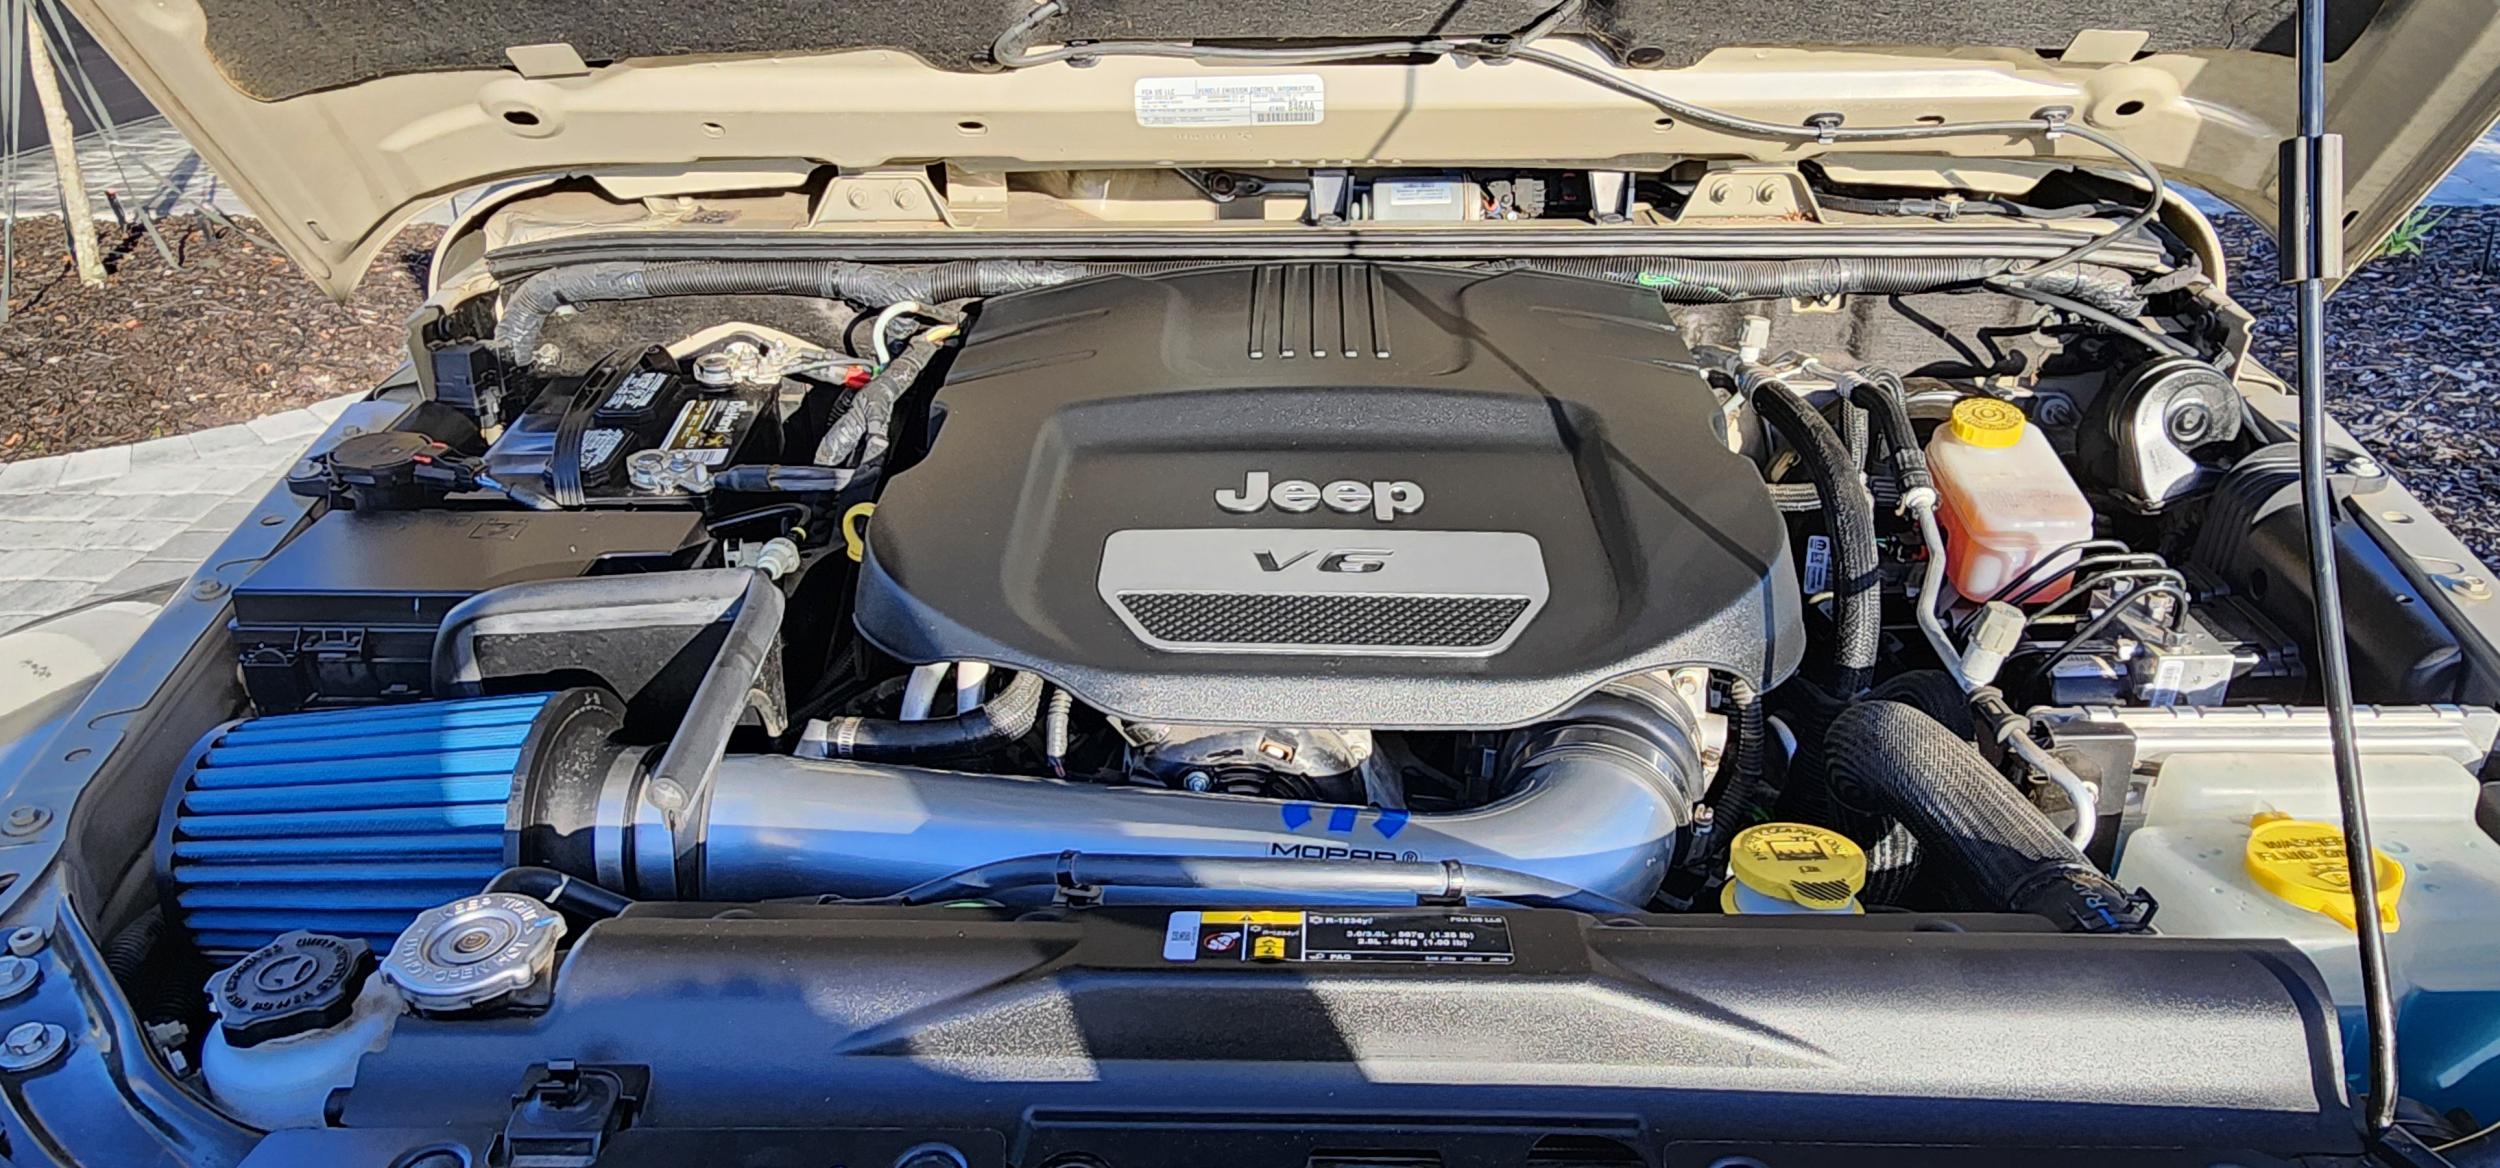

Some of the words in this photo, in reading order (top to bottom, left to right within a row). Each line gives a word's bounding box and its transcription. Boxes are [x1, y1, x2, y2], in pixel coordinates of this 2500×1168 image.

[1214, 471, 1425, 523] Jeep
[1253, 548, 1394, 573] V6
[2256, 850, 2318, 862] FLUID
[1452, 938, 1468, 947] lb)
[432, 962, 492, 983] OPEN
